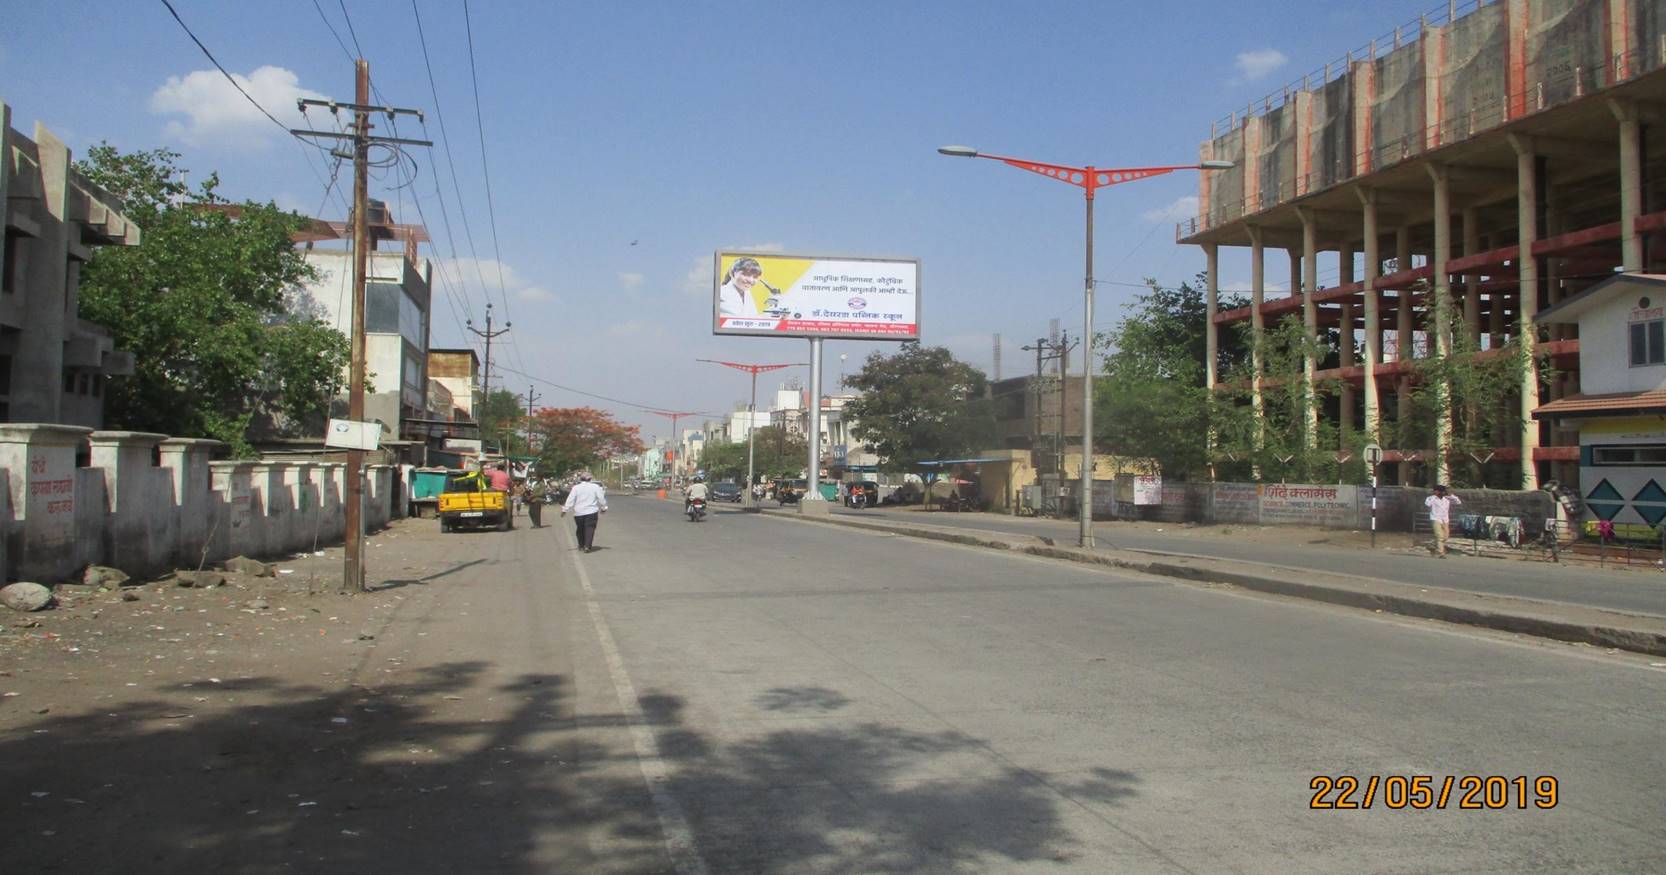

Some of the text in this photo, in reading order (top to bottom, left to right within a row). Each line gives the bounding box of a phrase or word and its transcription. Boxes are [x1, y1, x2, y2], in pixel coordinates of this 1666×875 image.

[883, 313, 903, 321] स्कूल
[1264, 484, 1289, 499] शिंदे
[1289, 485, 1338, 500] क्लासेस
